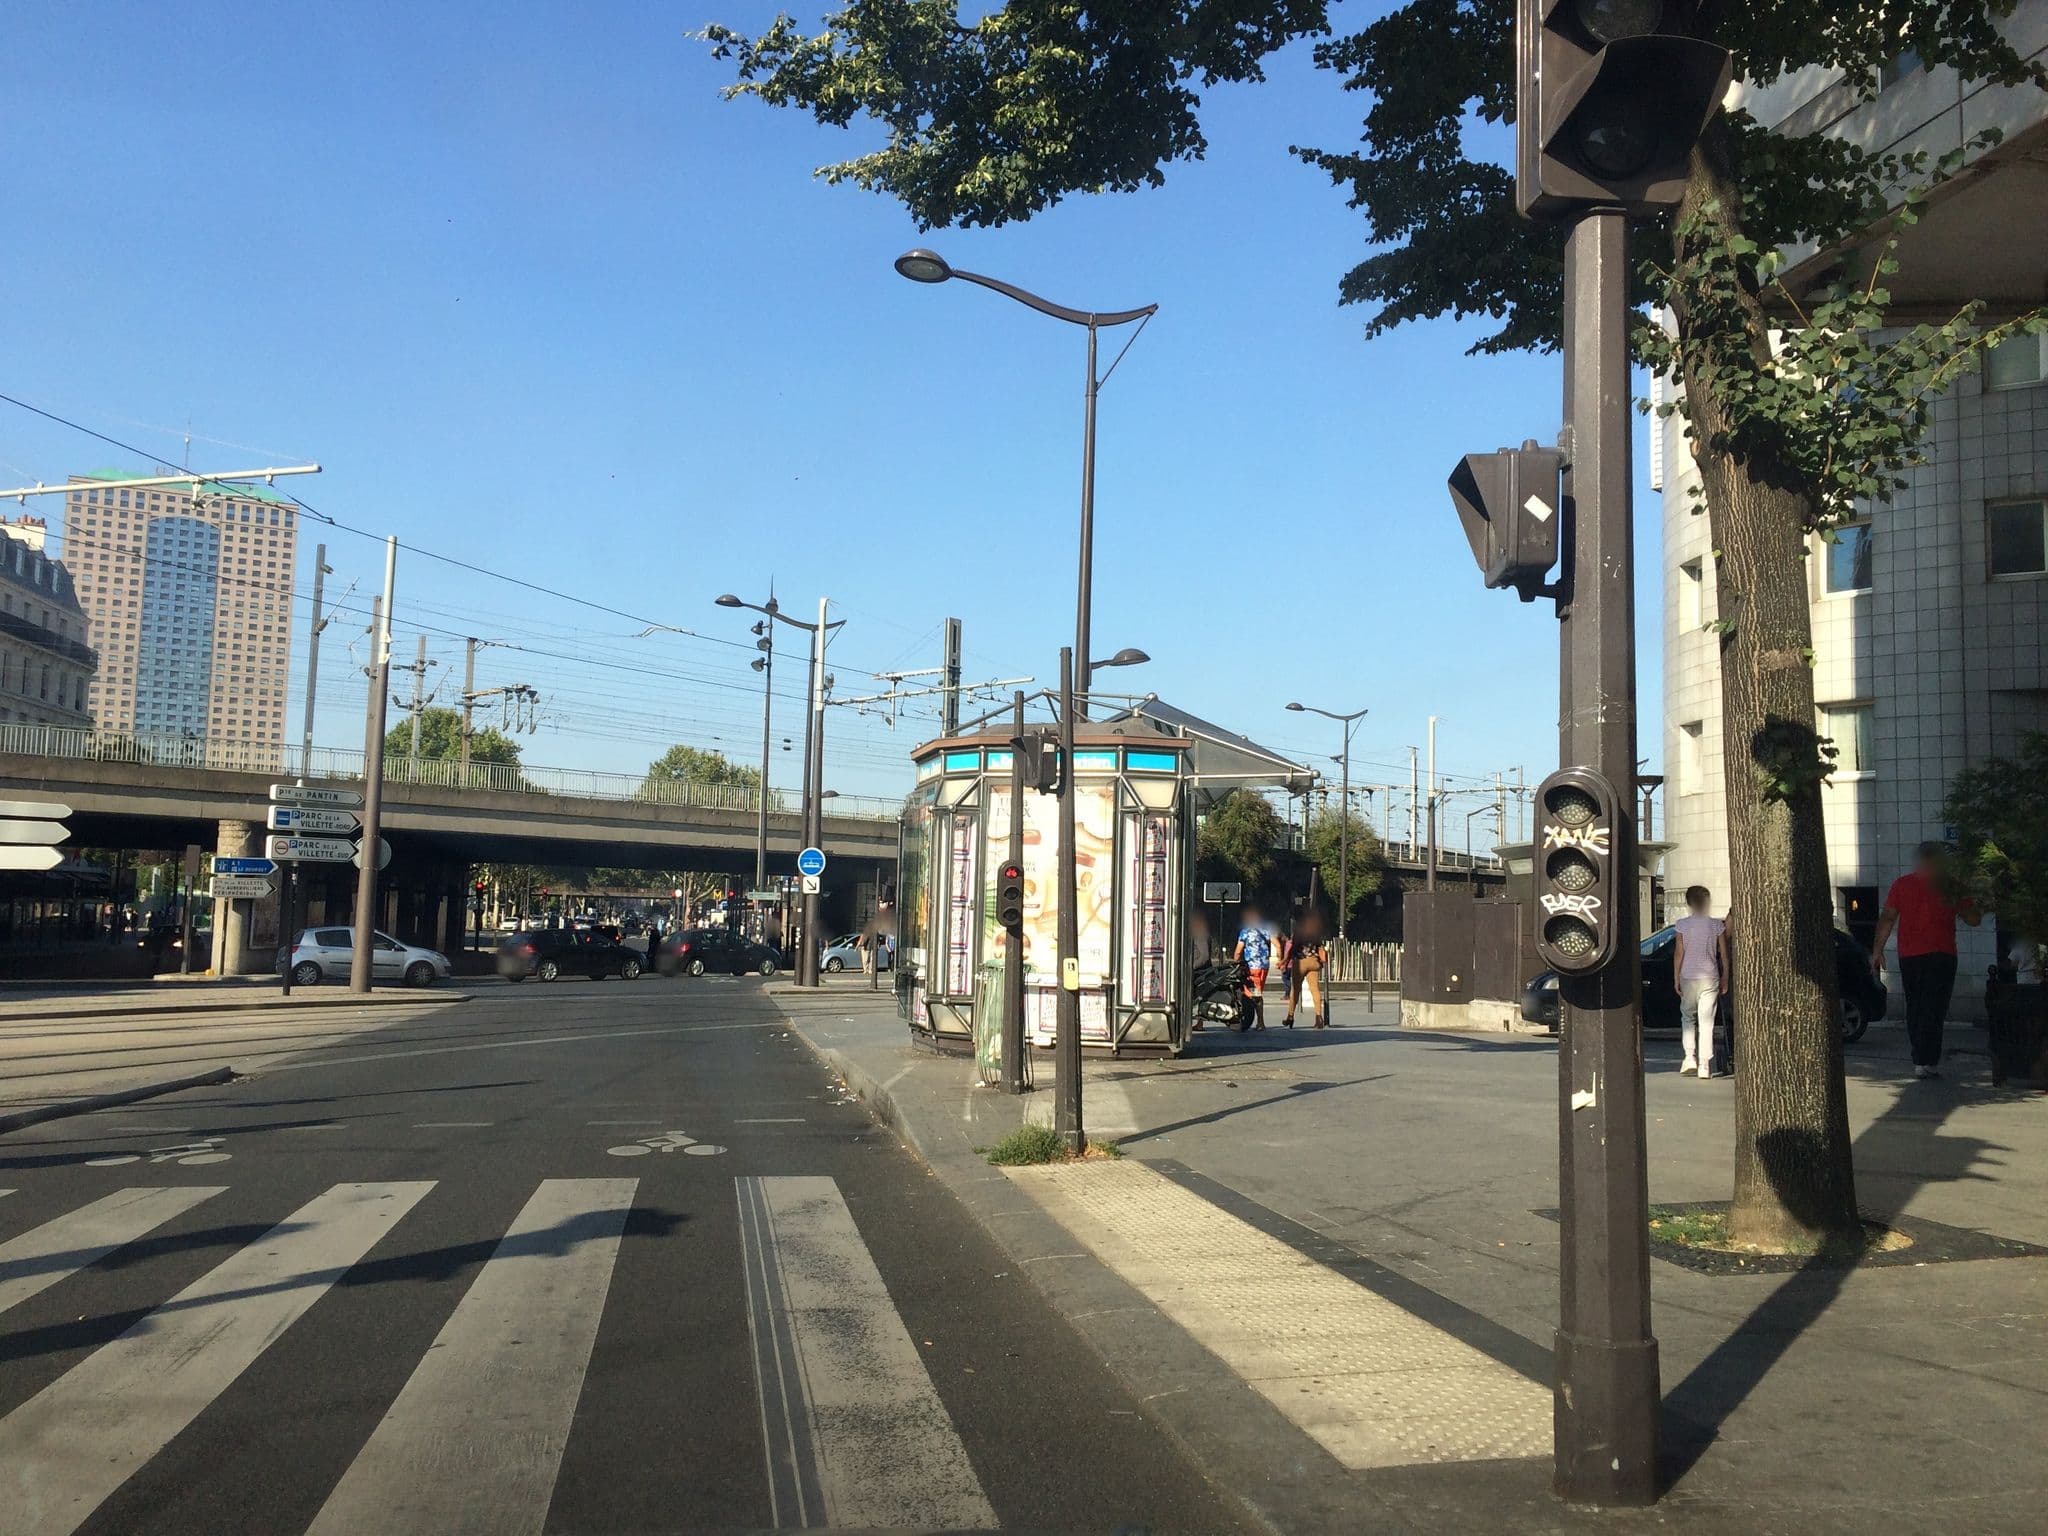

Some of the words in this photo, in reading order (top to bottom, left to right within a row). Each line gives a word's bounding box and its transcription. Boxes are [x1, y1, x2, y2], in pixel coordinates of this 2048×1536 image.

[306, 791, 338, 801] PANTIN
[301, 811, 322, 820] PARC
[298, 841, 320, 850] PARC
